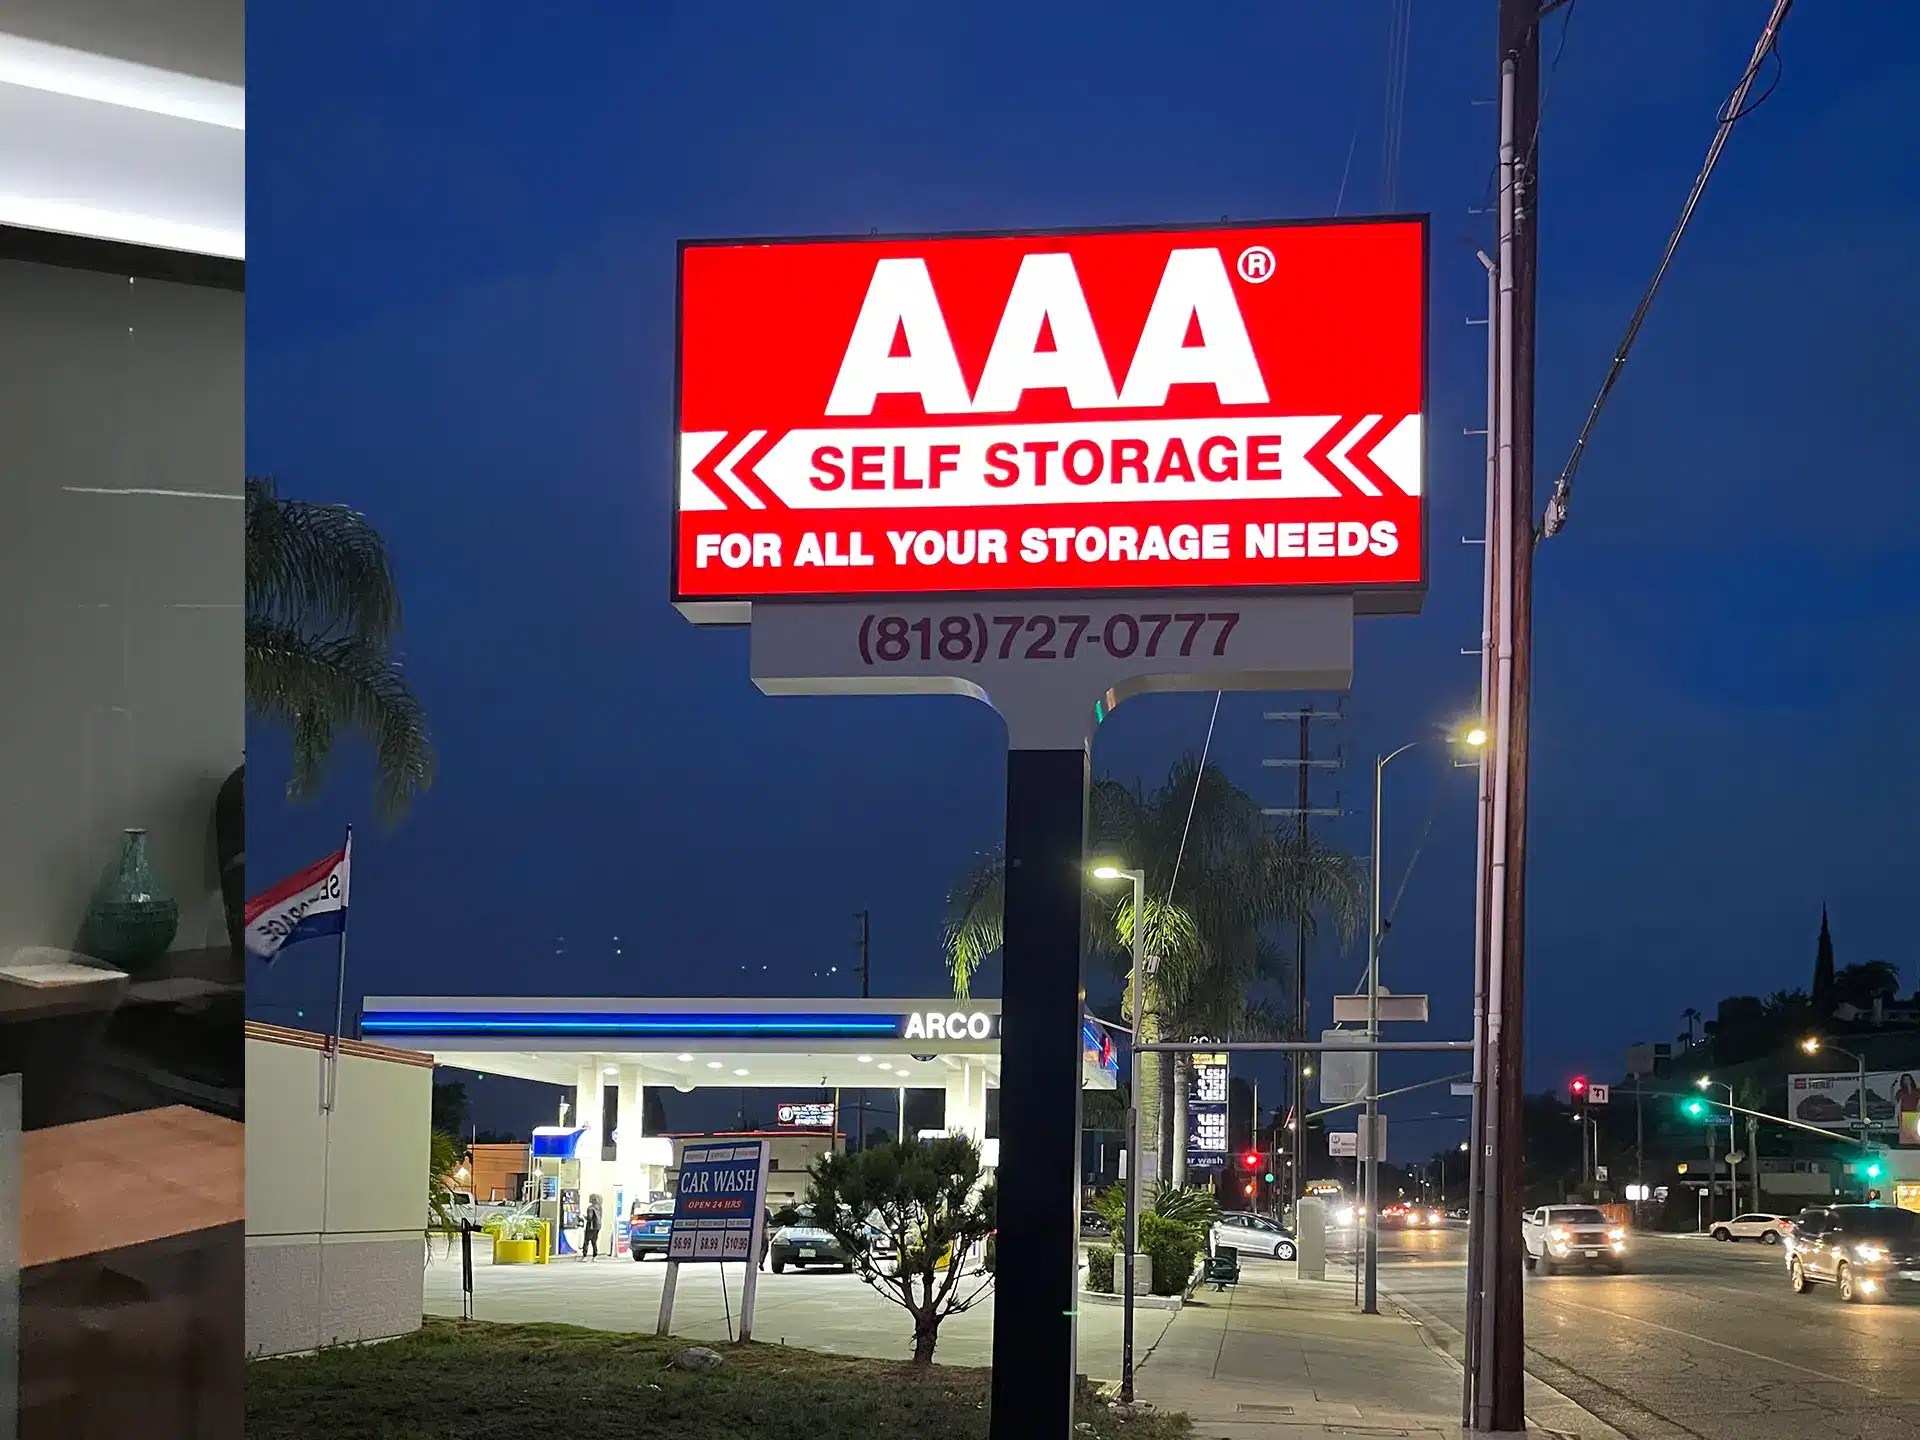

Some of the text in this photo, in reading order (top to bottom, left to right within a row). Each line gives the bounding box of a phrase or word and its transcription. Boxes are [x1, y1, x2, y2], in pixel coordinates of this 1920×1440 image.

[824, 247, 1270, 417] AAA
[809, 435, 1283, 491] SELF STORAGE
[695, 520, 1399, 569] FOR ALL YOUR STORAGE NEEDS
[857, 612, 1240, 664] (818)727-0777
[904, 1012, 991, 1039] ARCO
[681, 1169, 756, 1193] CAR WASH
[688, 1200, 742, 1209] OPEN 24 HRS
